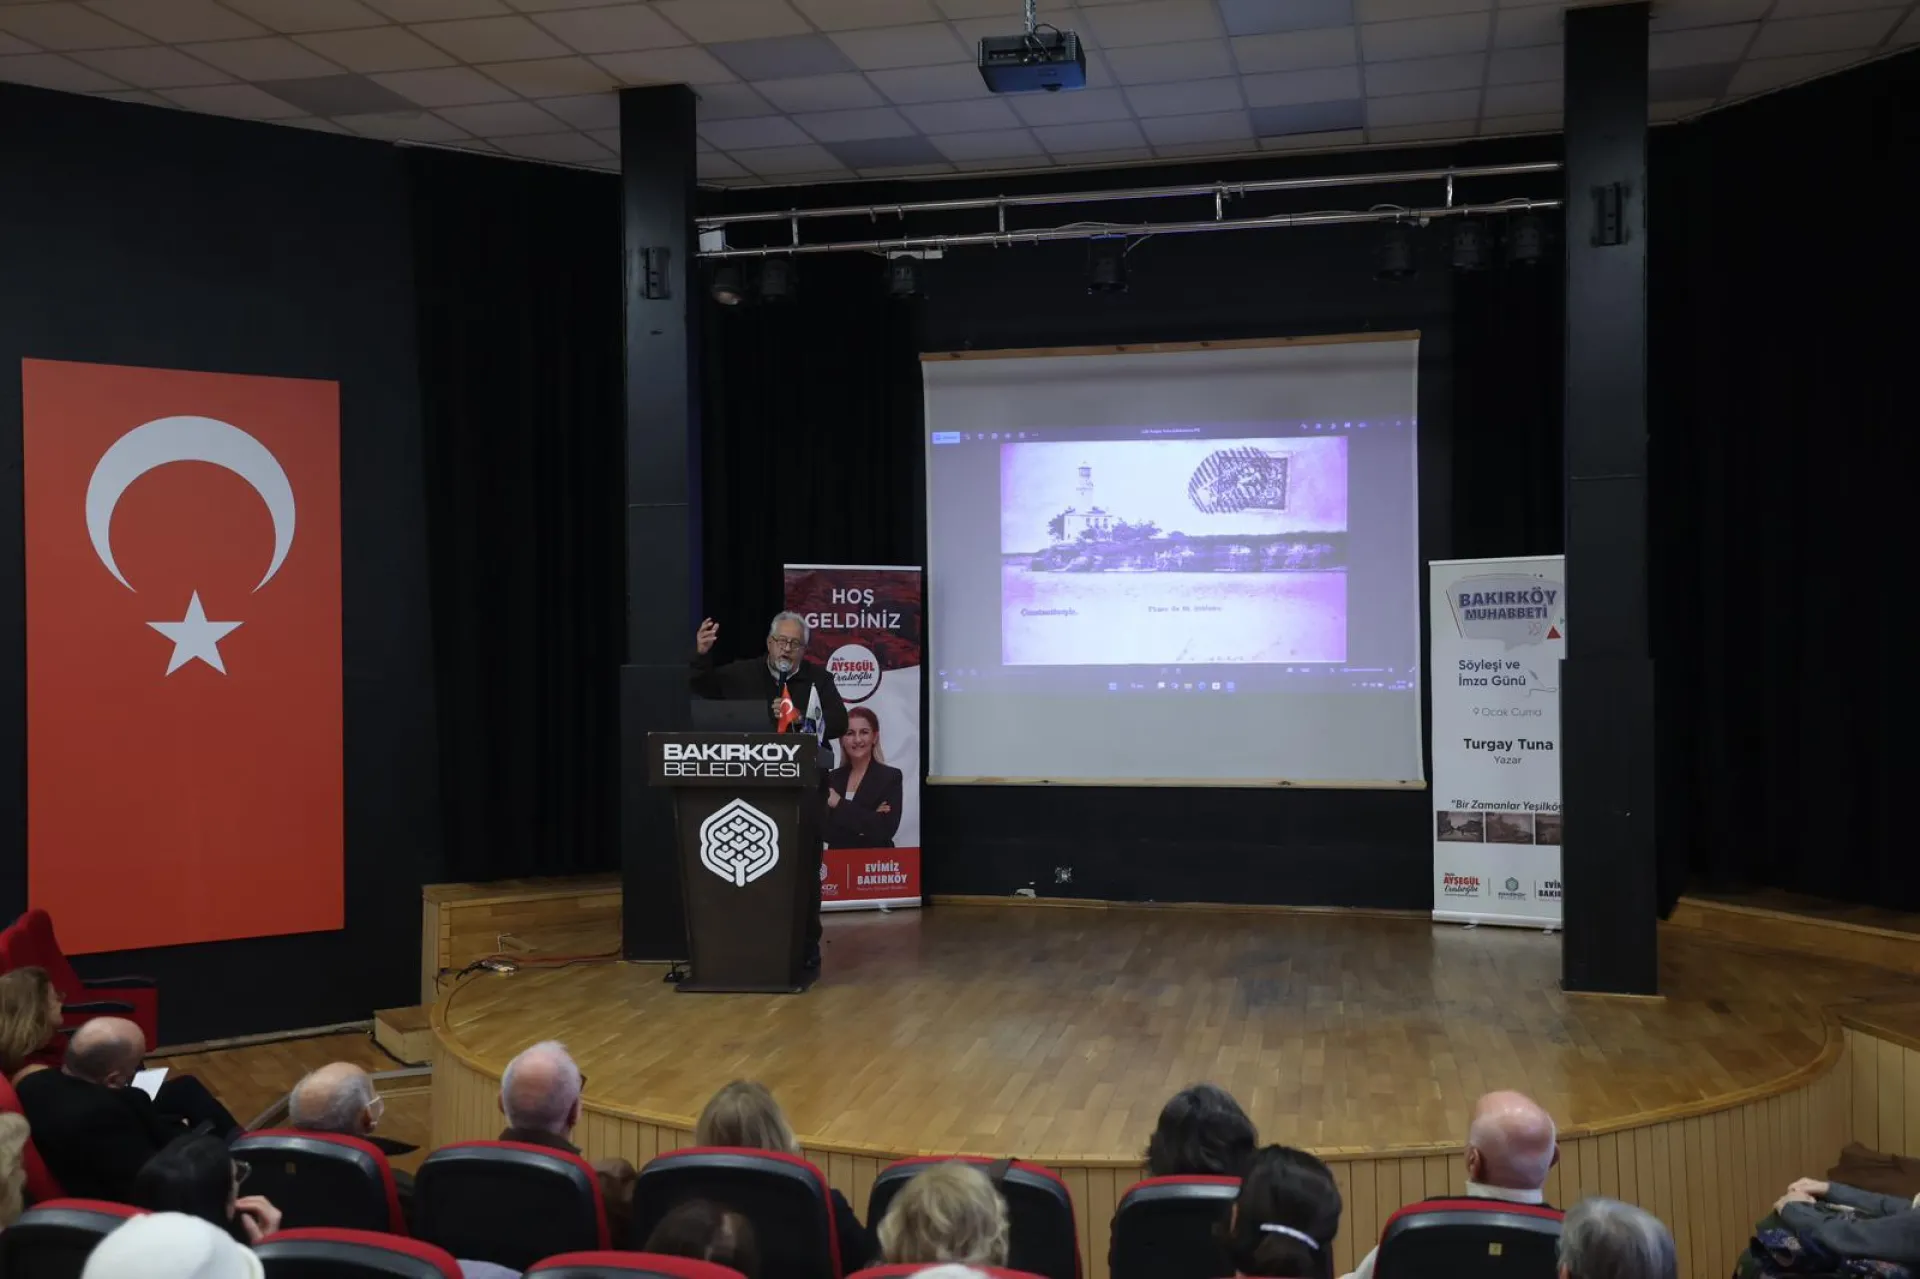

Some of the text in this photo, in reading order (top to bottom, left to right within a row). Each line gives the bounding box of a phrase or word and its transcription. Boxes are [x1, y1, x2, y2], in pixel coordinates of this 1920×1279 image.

[832, 588, 875, 607] HOŞ
[1458, 586, 1557, 608] BAKIRKÖY
[1464, 604, 1548, 620] MUHABBETİ
[804, 609, 900, 629] GELDİNİZ
[1458, 659, 1520, 672] Söyleşi ve
[1458, 673, 1526, 686] İmza Günü
[1464, 738, 1554, 752] Turgay Tuna
[664, 743, 801, 761] BAKIRKÖY
[1494, 755, 1522, 765] Yazar
[1471, 799, 1521, 811] Zamanlar
[864, 860, 900, 872] EVİMİZ
[857, 872, 908, 885] BAKIRKÖY
